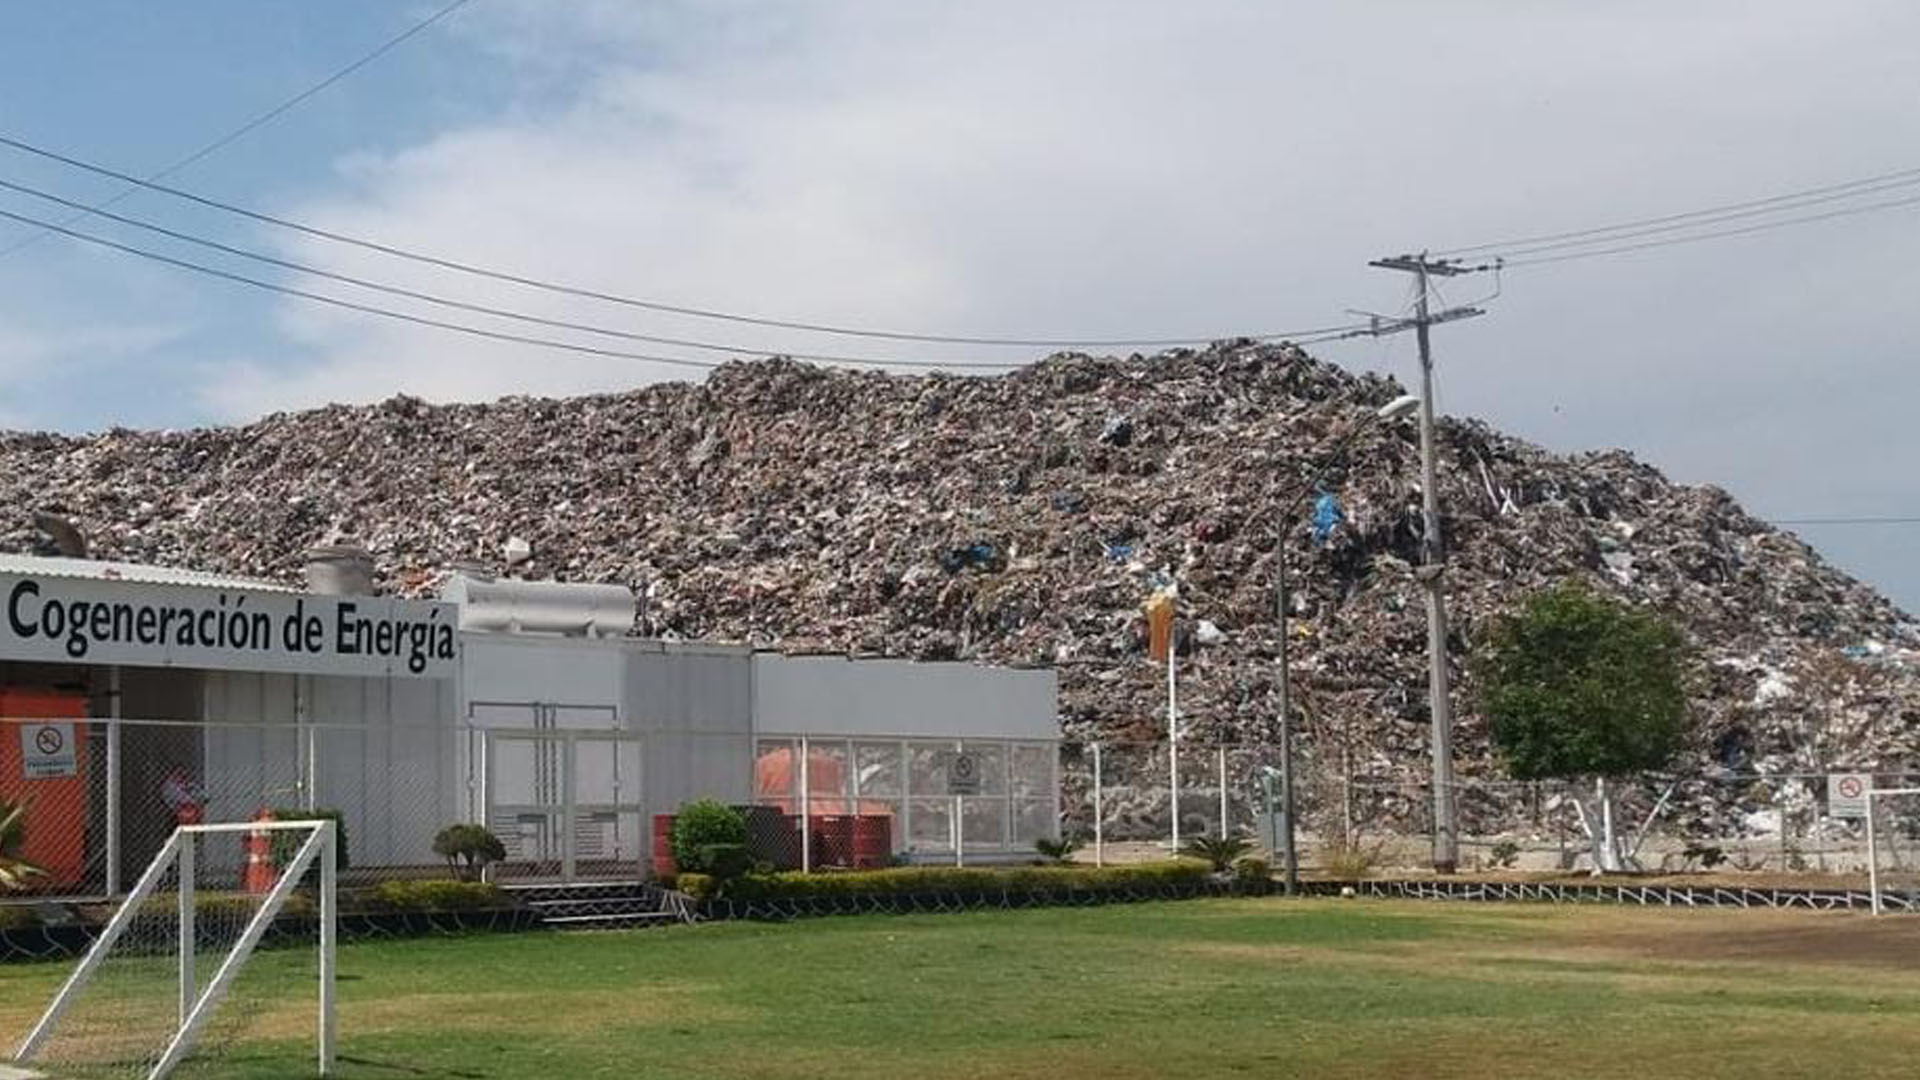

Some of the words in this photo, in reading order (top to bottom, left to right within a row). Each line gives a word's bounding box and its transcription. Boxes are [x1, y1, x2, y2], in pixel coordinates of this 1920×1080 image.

[8, 579, 270, 658] Cogeneración
[283, 599, 323, 653] de
[336, 602, 455, 674] Energía
